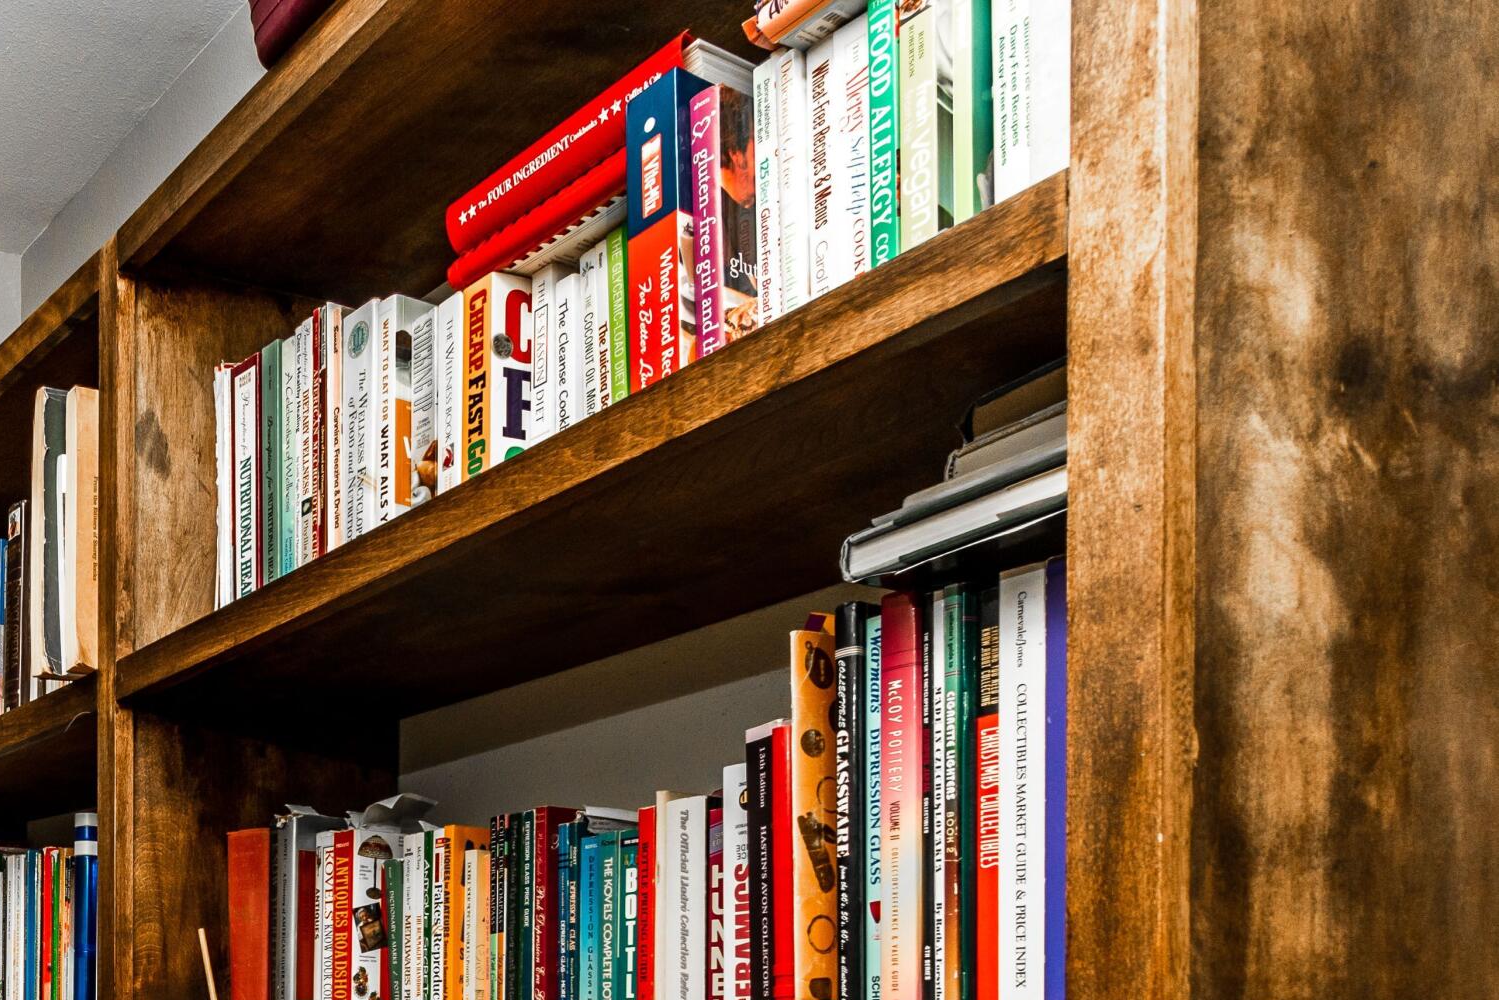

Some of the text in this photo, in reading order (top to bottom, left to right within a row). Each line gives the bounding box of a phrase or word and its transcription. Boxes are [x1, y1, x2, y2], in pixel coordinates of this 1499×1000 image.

[811, 60, 832, 230] Wheat-Free Recipes Menus
[870, 22, 892, 227] FOOD ALLERGY
[487, 135, 570, 205] FOUR INGREDIENT
[694, 149, 719, 328] gluten-free girl and
[760, 157, 772, 313] 125 Gluten-Free Bread
[611, 263, 625, 386] GLYCEMIC-LOAD DIET
[659, 247, 674, 346] Whole Food
[382, 356, 389, 370] TO
[558, 299, 569, 386] The Cleanse
[583, 312, 596, 386] COCONUT OIL
[598, 321, 609, 346] The
[301, 390, 311, 495] DIETARY WELLNESS
[348, 410, 357, 448] FOOD
[357, 369, 368, 463] The WELLNESS
[380, 425, 389, 469] WHAT
[240, 456, 252, 558] NUTRITIONAL
[380, 475, 389, 508] AILS
[1015, 590, 1027, 668] Carnevale/Jones
[836, 660, 849, 857] COLLECTIBLE GLASSWARE
[870, 627, 882, 885] Warman's DEPRESSION GLASS
[888, 679, 903, 833] McCOY POTTERY VOLUME
[1014, 682, 1028, 780] COLLECTIBLES
[759, 747, 767, 808] 13th Edition
[945, 690, 956, 842] CIGARETTE LIGHTERS BOOK
[680, 809, 689, 835] The
[980, 727, 1000, 869] CHRISTMAS COLLECTIBLES
[1015, 782, 1028, 838] MARKET
[324, 850, 333, 920] KOVELS
[443, 837, 451, 880] ANTIQUES
[603, 857, 613, 878] THE
[679, 838, 689, 871] Official
[1015, 842, 1028, 886] GUIDE
[334, 857, 348, 928] ANTIQUES
[433, 885, 443, 925] Fakes
[761, 882, 769, 914] AVON
[1015, 889, 1027, 900] &
[1015, 904, 1027, 942] PRICE
[323, 956, 333, 981] YOUR
[324, 924, 333, 953] KNOW
[603, 923, 613, 978] COMPLETE
[640, 932, 648, 983] GUIDE
[679, 916, 688, 967] Collection
[761, 917, 770, 998] COLLECTOR'S
[1015, 945, 1027, 989] INDEX
[891, 970, 899, 992] GUIDE
